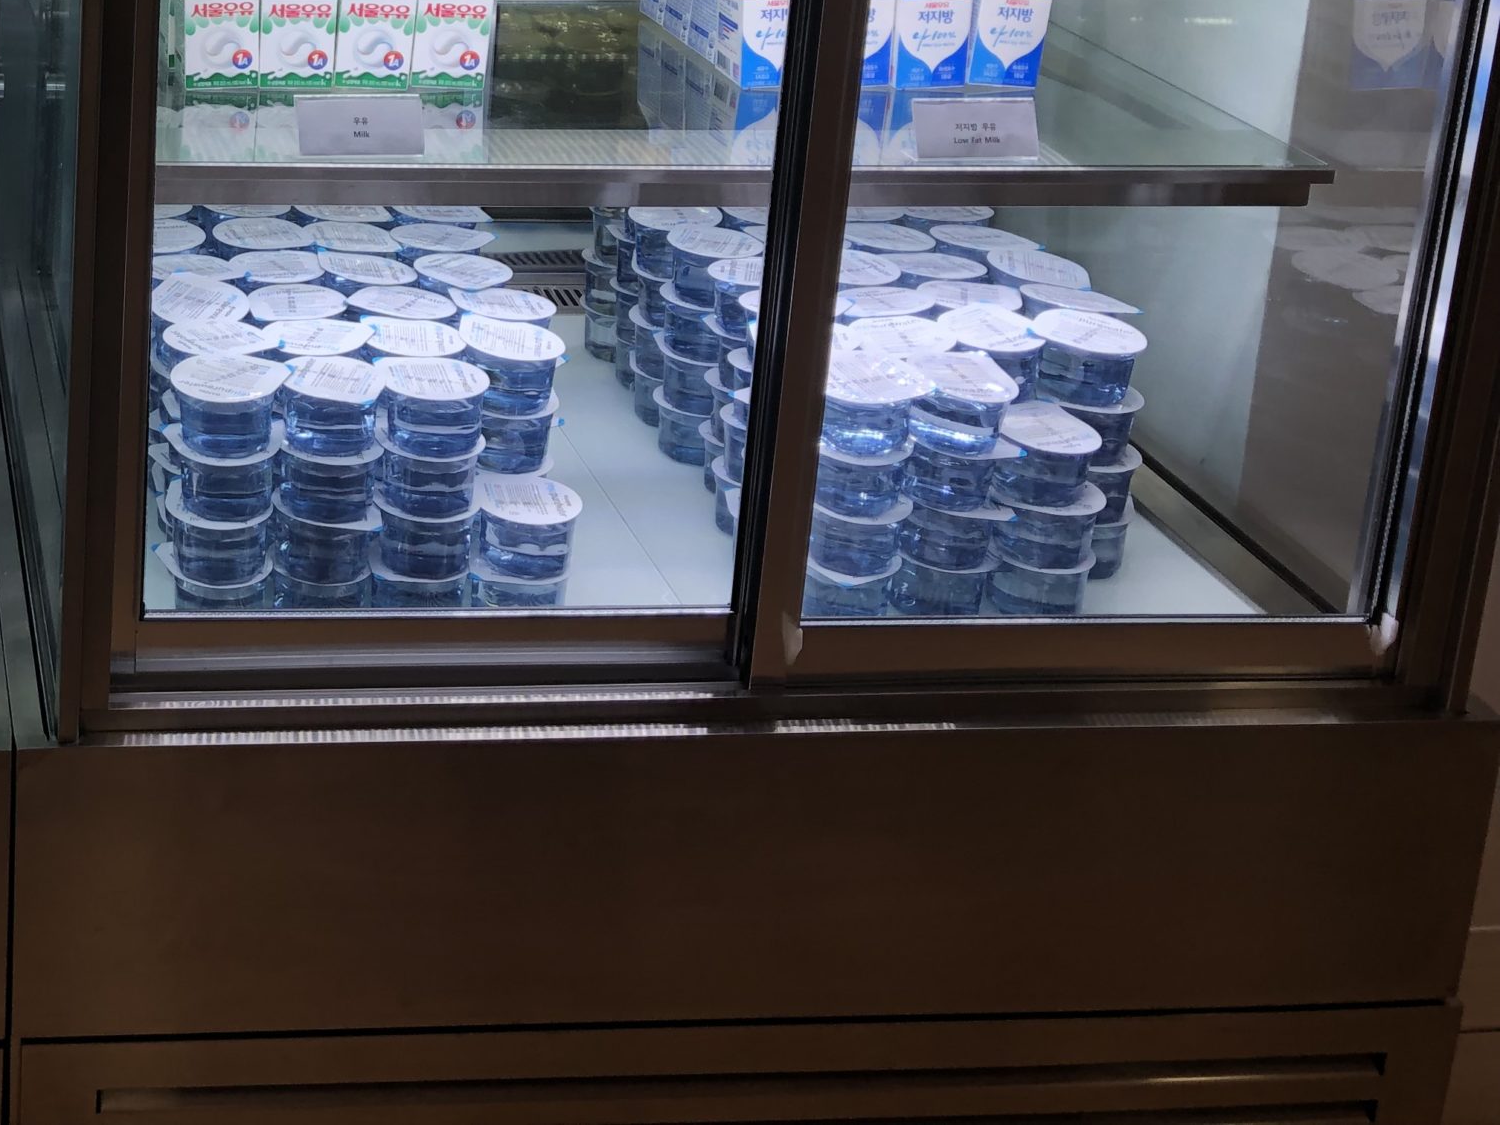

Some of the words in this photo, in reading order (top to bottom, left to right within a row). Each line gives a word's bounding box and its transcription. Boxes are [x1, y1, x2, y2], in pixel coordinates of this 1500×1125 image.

[190, 2, 254, 19] 서울우유
[268, 3, 332, 19] 서울우유
[347, 3, 411, 20] 서울우유
[423, 3, 487, 20] 서울우유
[917, 10, 955, 24] 저지방
[997, 6, 1034, 22] 저지방
[353, 116, 369, 126] 우유
[955, 122, 978, 132] 저지방
[982, 122, 997, 131] 우유
[353, 130, 370, 138] Milk
[953, 136, 969, 144] Low
[984, 136, 1001, 144] Milk
